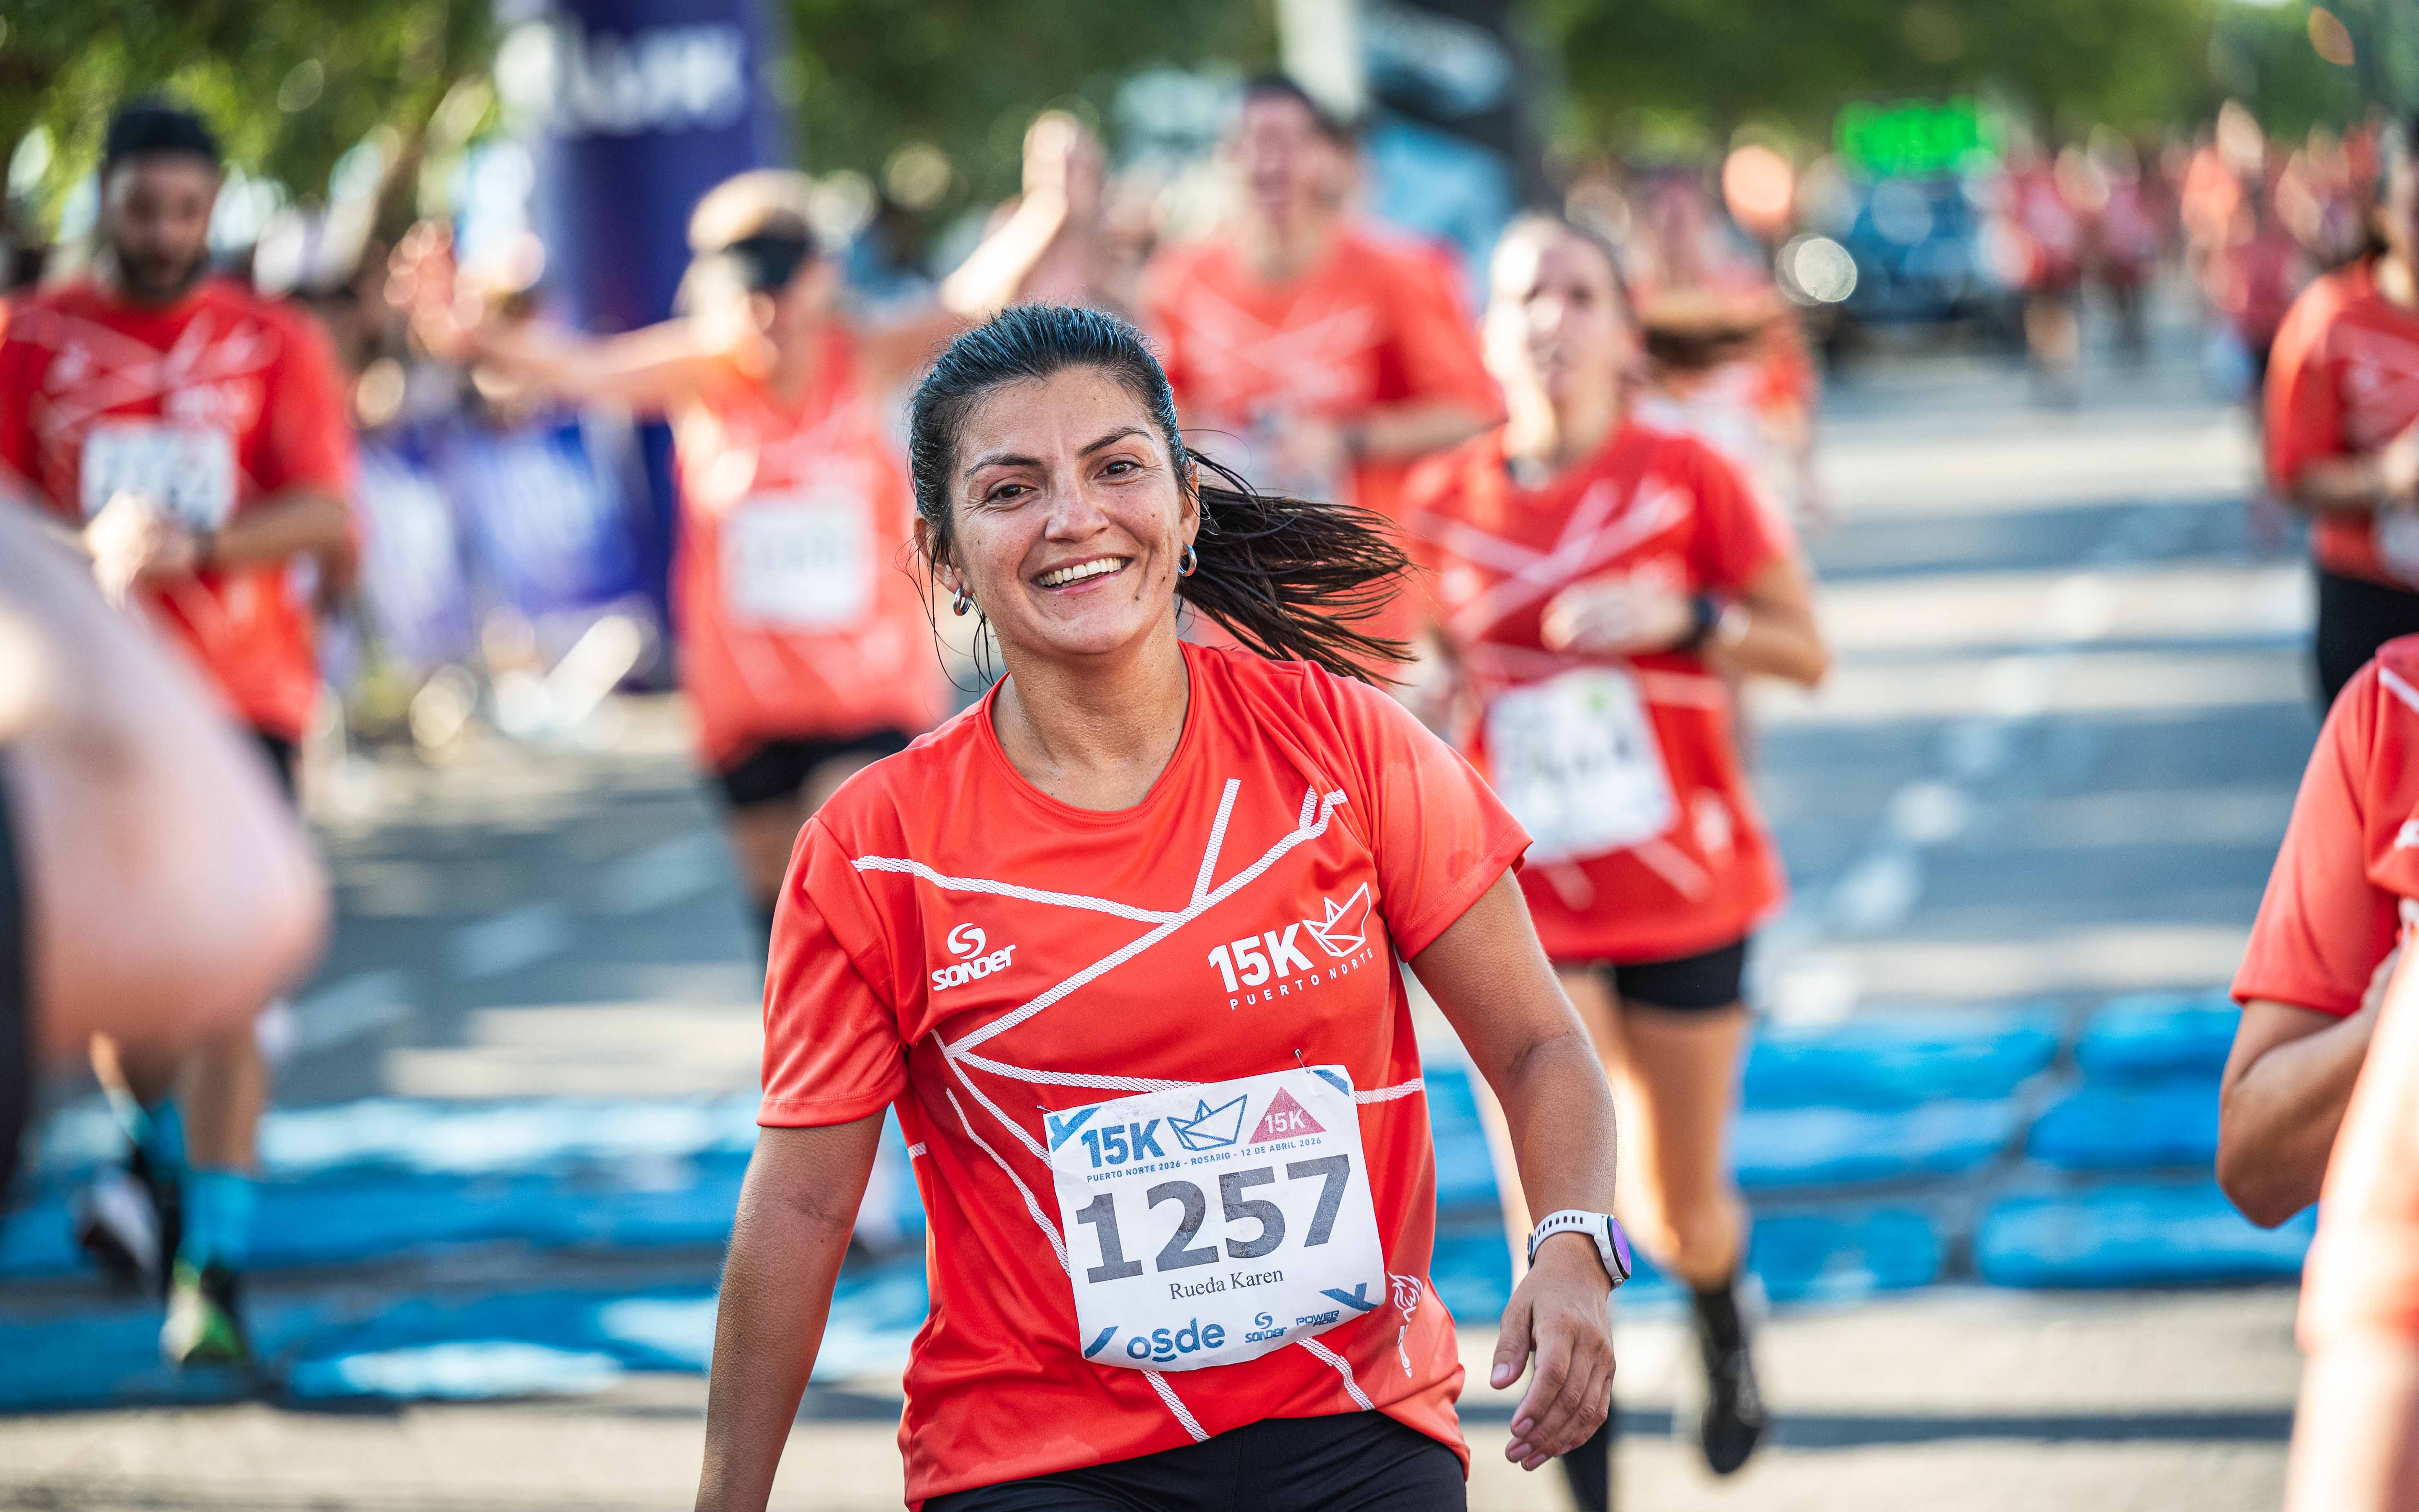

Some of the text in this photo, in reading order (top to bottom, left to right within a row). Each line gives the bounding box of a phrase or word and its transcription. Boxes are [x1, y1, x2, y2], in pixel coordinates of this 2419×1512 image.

[1208, 922, 1315, 993] 15K
[1229, 948, 1374, 1010] PUERTO NORTE
[1081, 1119, 1166, 1168] 15K
[1264, 1109, 1307, 1134] 15K
[1087, 1170, 1122, 1183] PUERTO
[1126, 1164, 1156, 1176] NORTE
[1159, 1160, 1181, 1170] 2026
[1191, 1152, 1230, 1166] ROSARIO
[1269, 1142, 1296, 1152] ABRIL
[1300, 1137, 1322, 1147] 2026
[1076, 1154, 1351, 1284] 1257
[1168, 1269, 1285, 1300] Rueda Karen
[1126, 1317, 1226, 1361] osde
[1296, 1310, 1339, 1326] POWER
